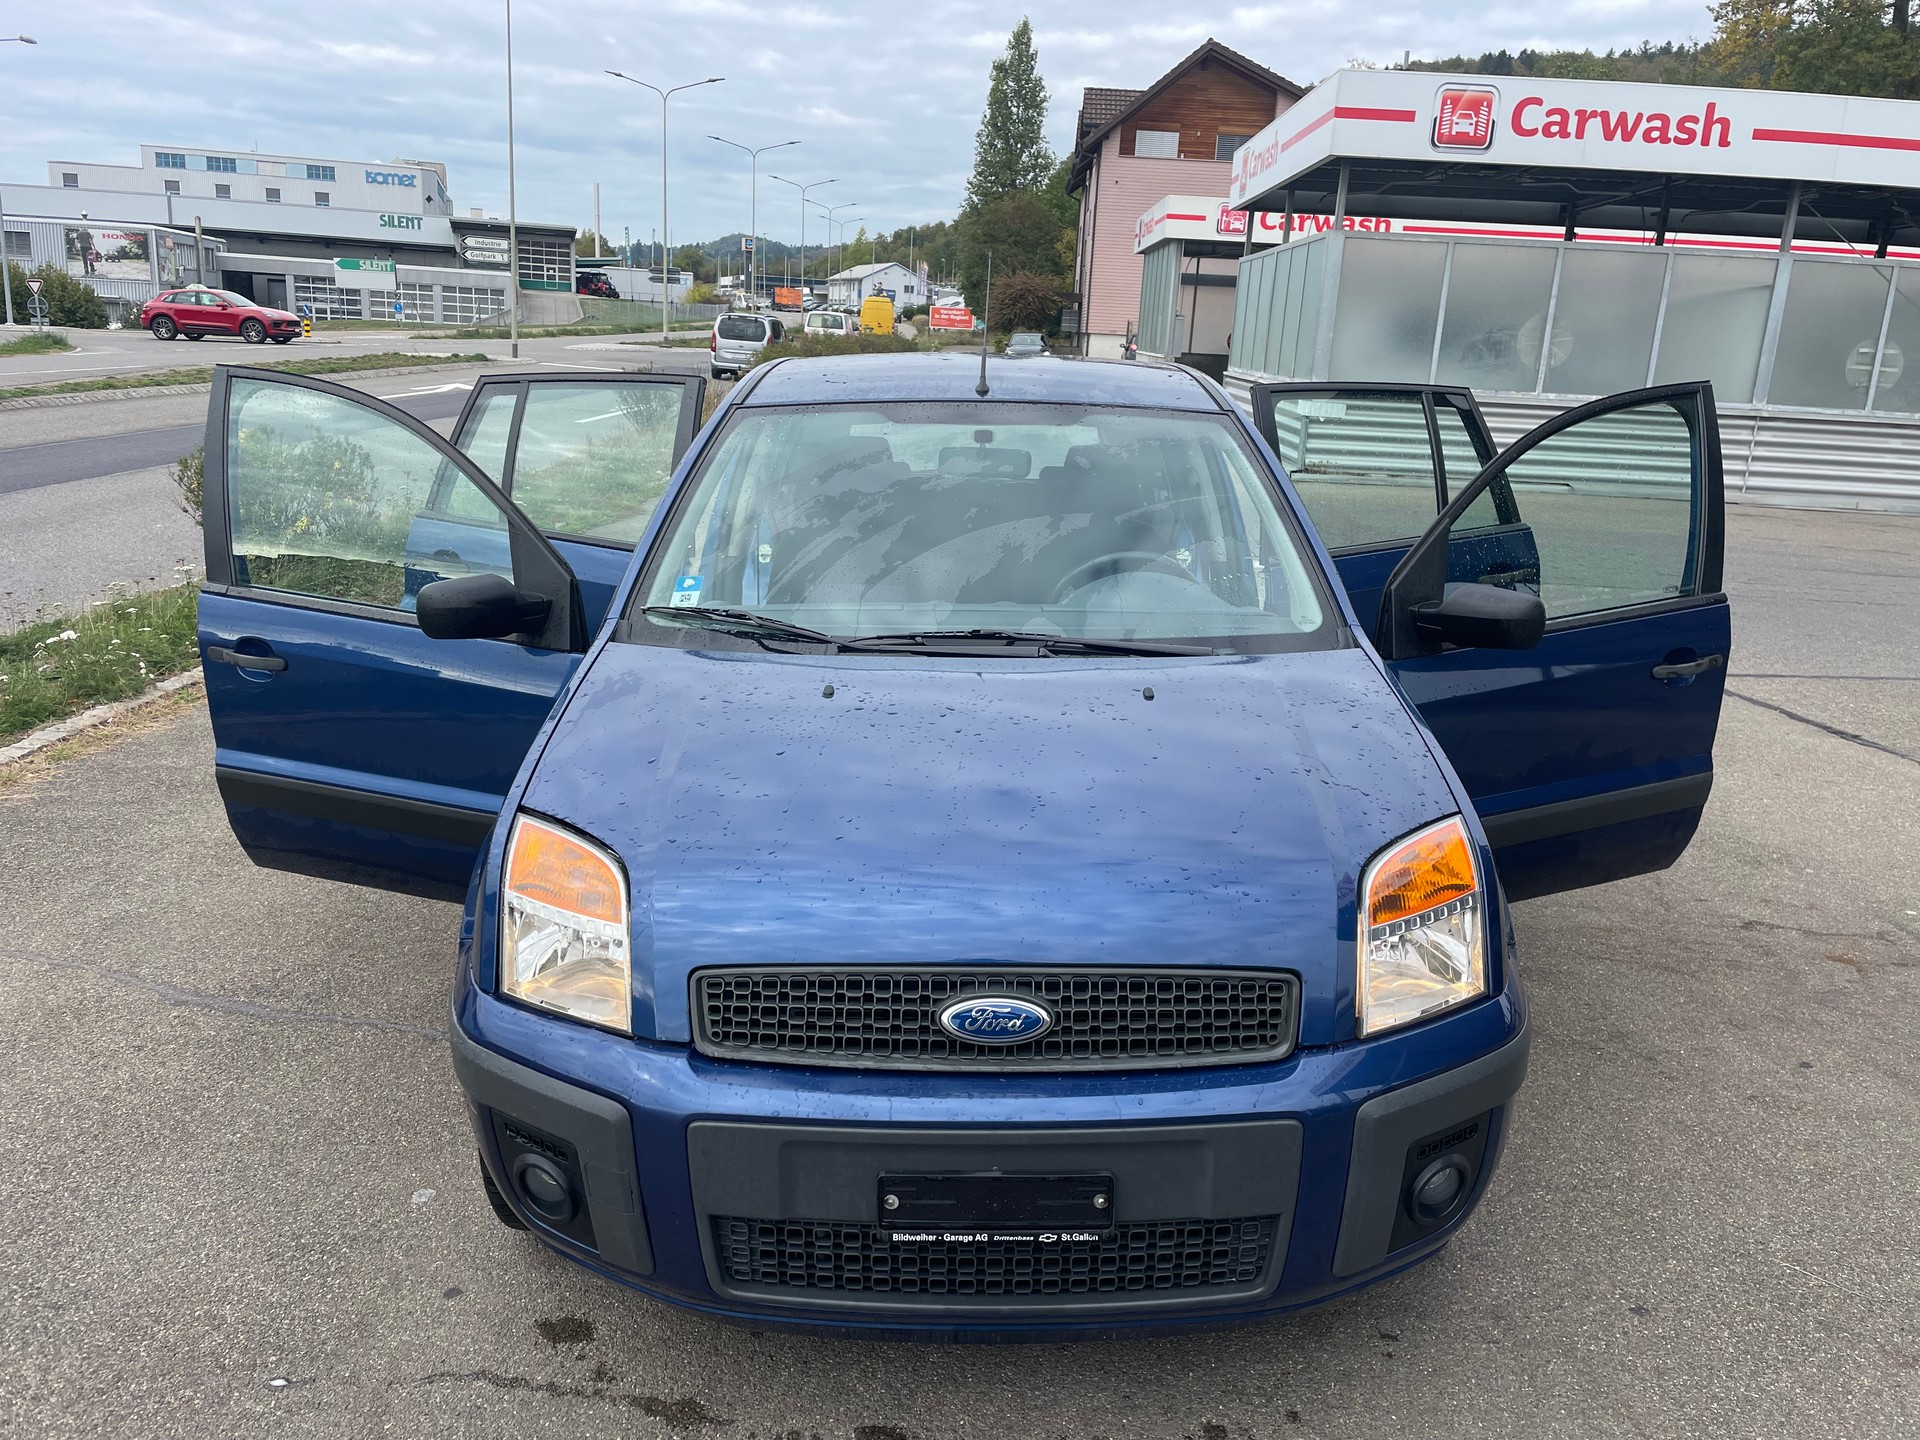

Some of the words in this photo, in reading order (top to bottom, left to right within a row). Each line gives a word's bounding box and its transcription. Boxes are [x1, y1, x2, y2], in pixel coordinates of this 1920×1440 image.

[1511, 96, 1731, 148] Carwash
[379, 214, 423, 230] SILENT
[102, 233, 145, 241] HONDA
[474, 239, 502, 247] Industrie
[470, 251, 497, 260] Golfpark
[359, 260, 392, 271] SILENT
[965, 1006, 1026, 1032] Ford
[892, 1233, 937, 1241] Bildweiher
[943, 1233, 974, 1242] Garage
[974, 1233, 988, 1241] AG
